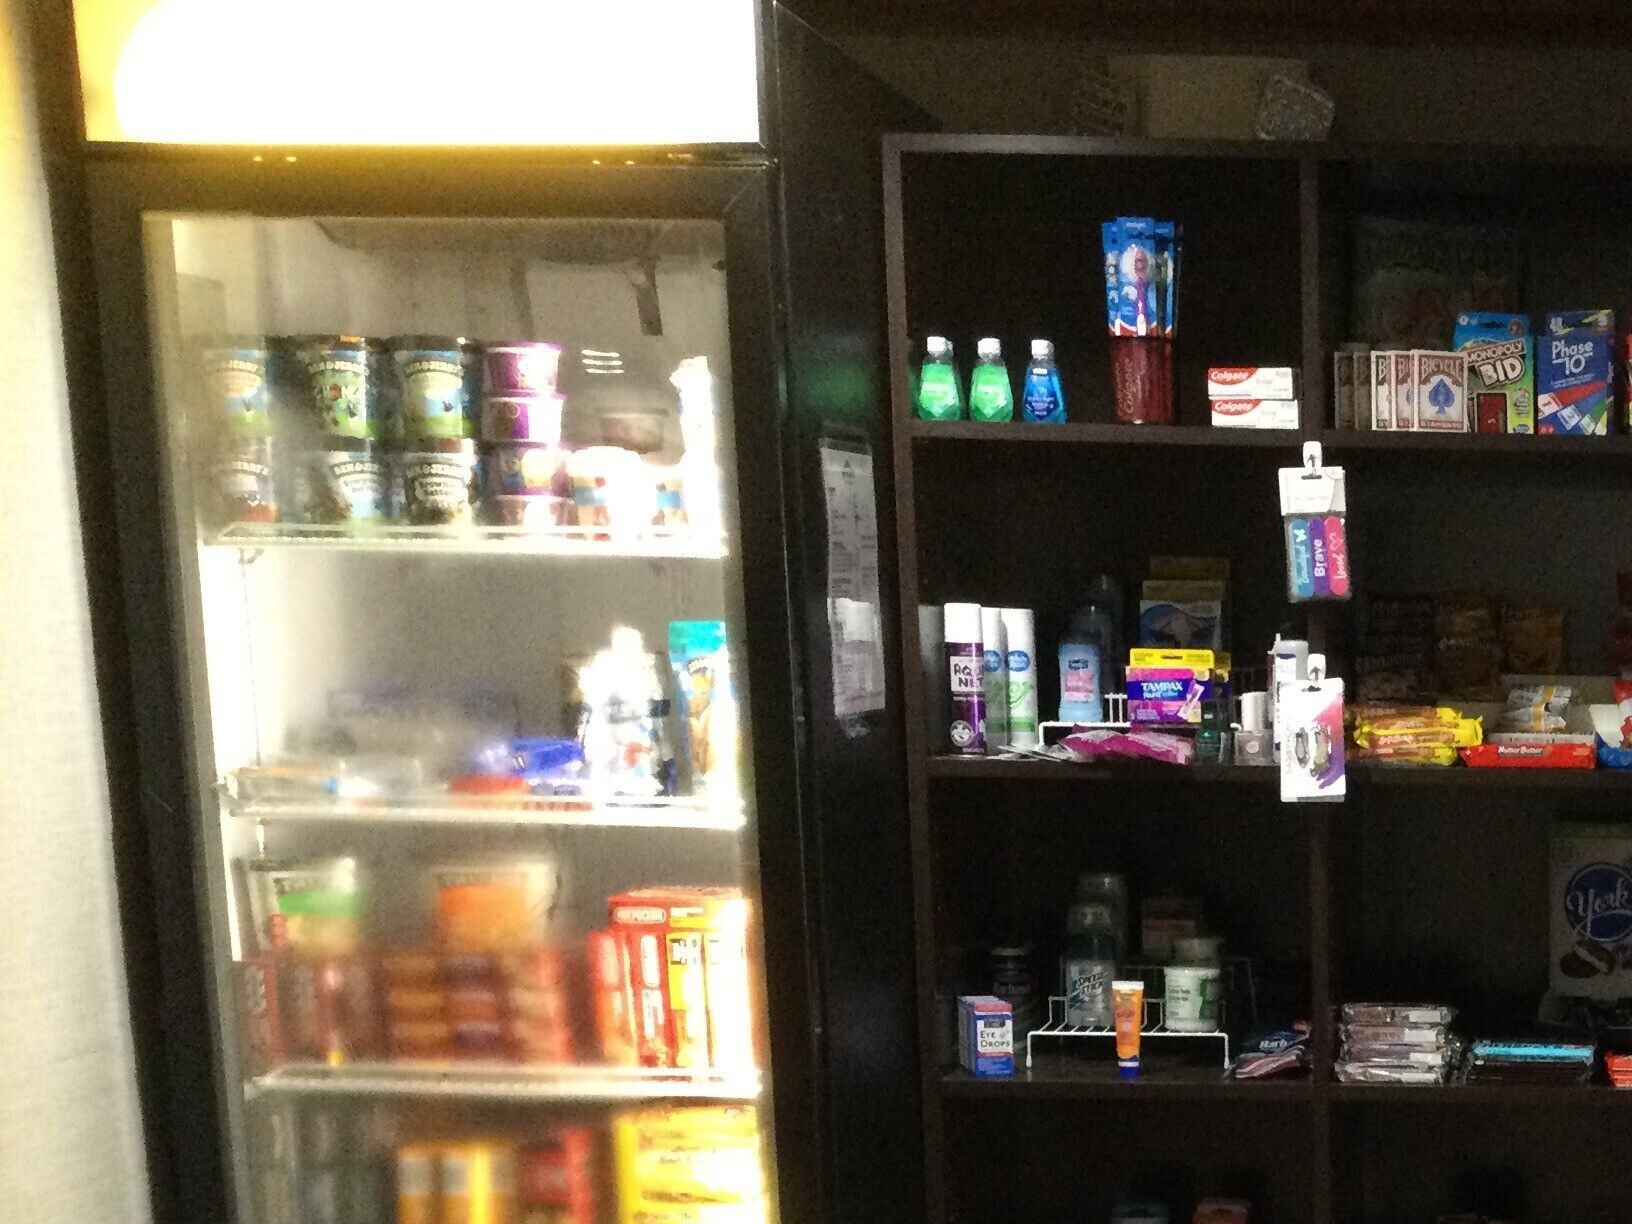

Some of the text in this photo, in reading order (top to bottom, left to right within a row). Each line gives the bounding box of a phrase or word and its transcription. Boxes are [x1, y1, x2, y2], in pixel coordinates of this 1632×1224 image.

[1464, 340, 1523, 366] MONOPOLY
[1552, 340, 1594, 361] Phase
[1420, 356, 1463, 384] BICYCLE
[1479, 355, 1523, 387] BID
[1565, 353, 1586, 375] 10
[1210, 370, 1250, 382] Colgate
[1214, 401, 1254, 413] Colgate
[1313, 538, 1327, 577] Brave
[1140, 681, 1184, 692] TAMPAX
[1498, 744, 1519, 754] Nutter
[980, 1040, 1011, 1048] DROPS
